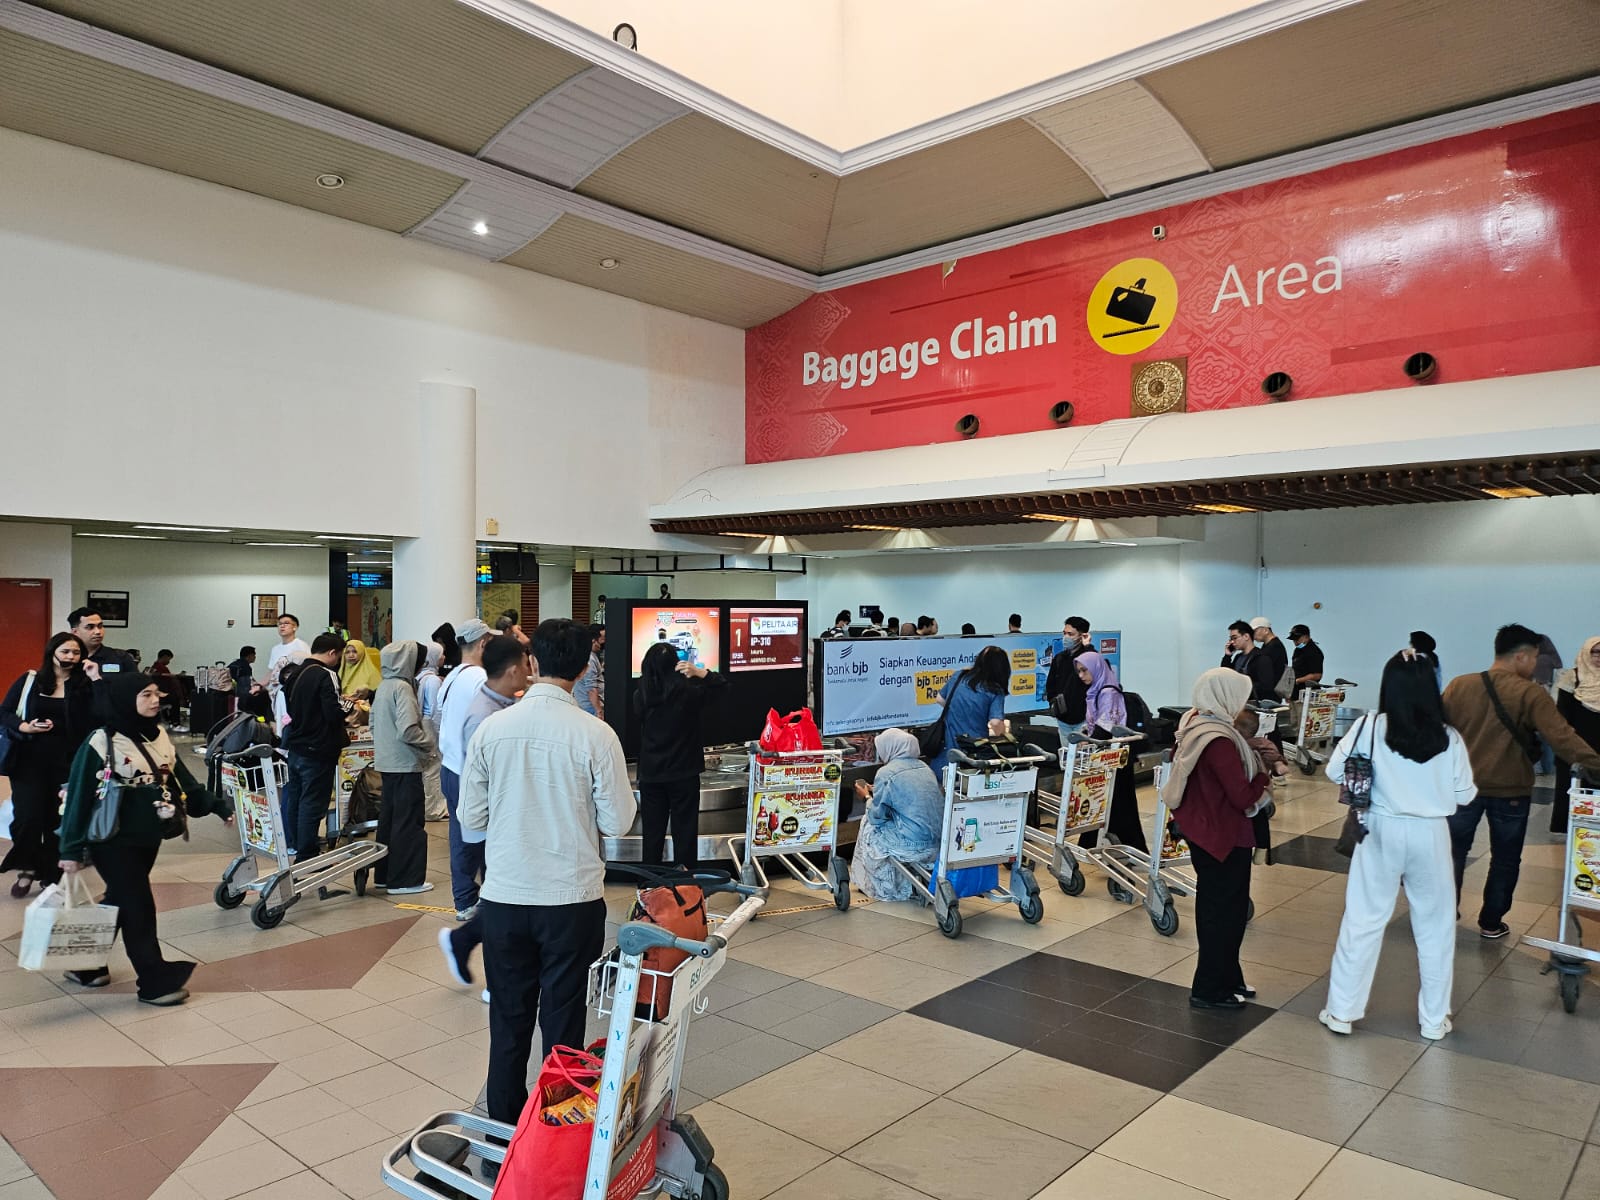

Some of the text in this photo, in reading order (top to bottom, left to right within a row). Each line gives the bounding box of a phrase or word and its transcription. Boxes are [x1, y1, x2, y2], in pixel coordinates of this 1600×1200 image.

[1212, 254, 1344, 315] Area
[802, 310, 1057, 391] Baggage Claim
[761, 620, 798, 628] PELITA AIR
[735, 628, 742, 647] 1
[827, 661, 869, 676] bank bjb
[879, 657, 914, 670] Siapkan
[916, 654, 956, 668] Keuangan
[879, 675, 912, 687] dengan
[917, 676, 930, 688] bjb
